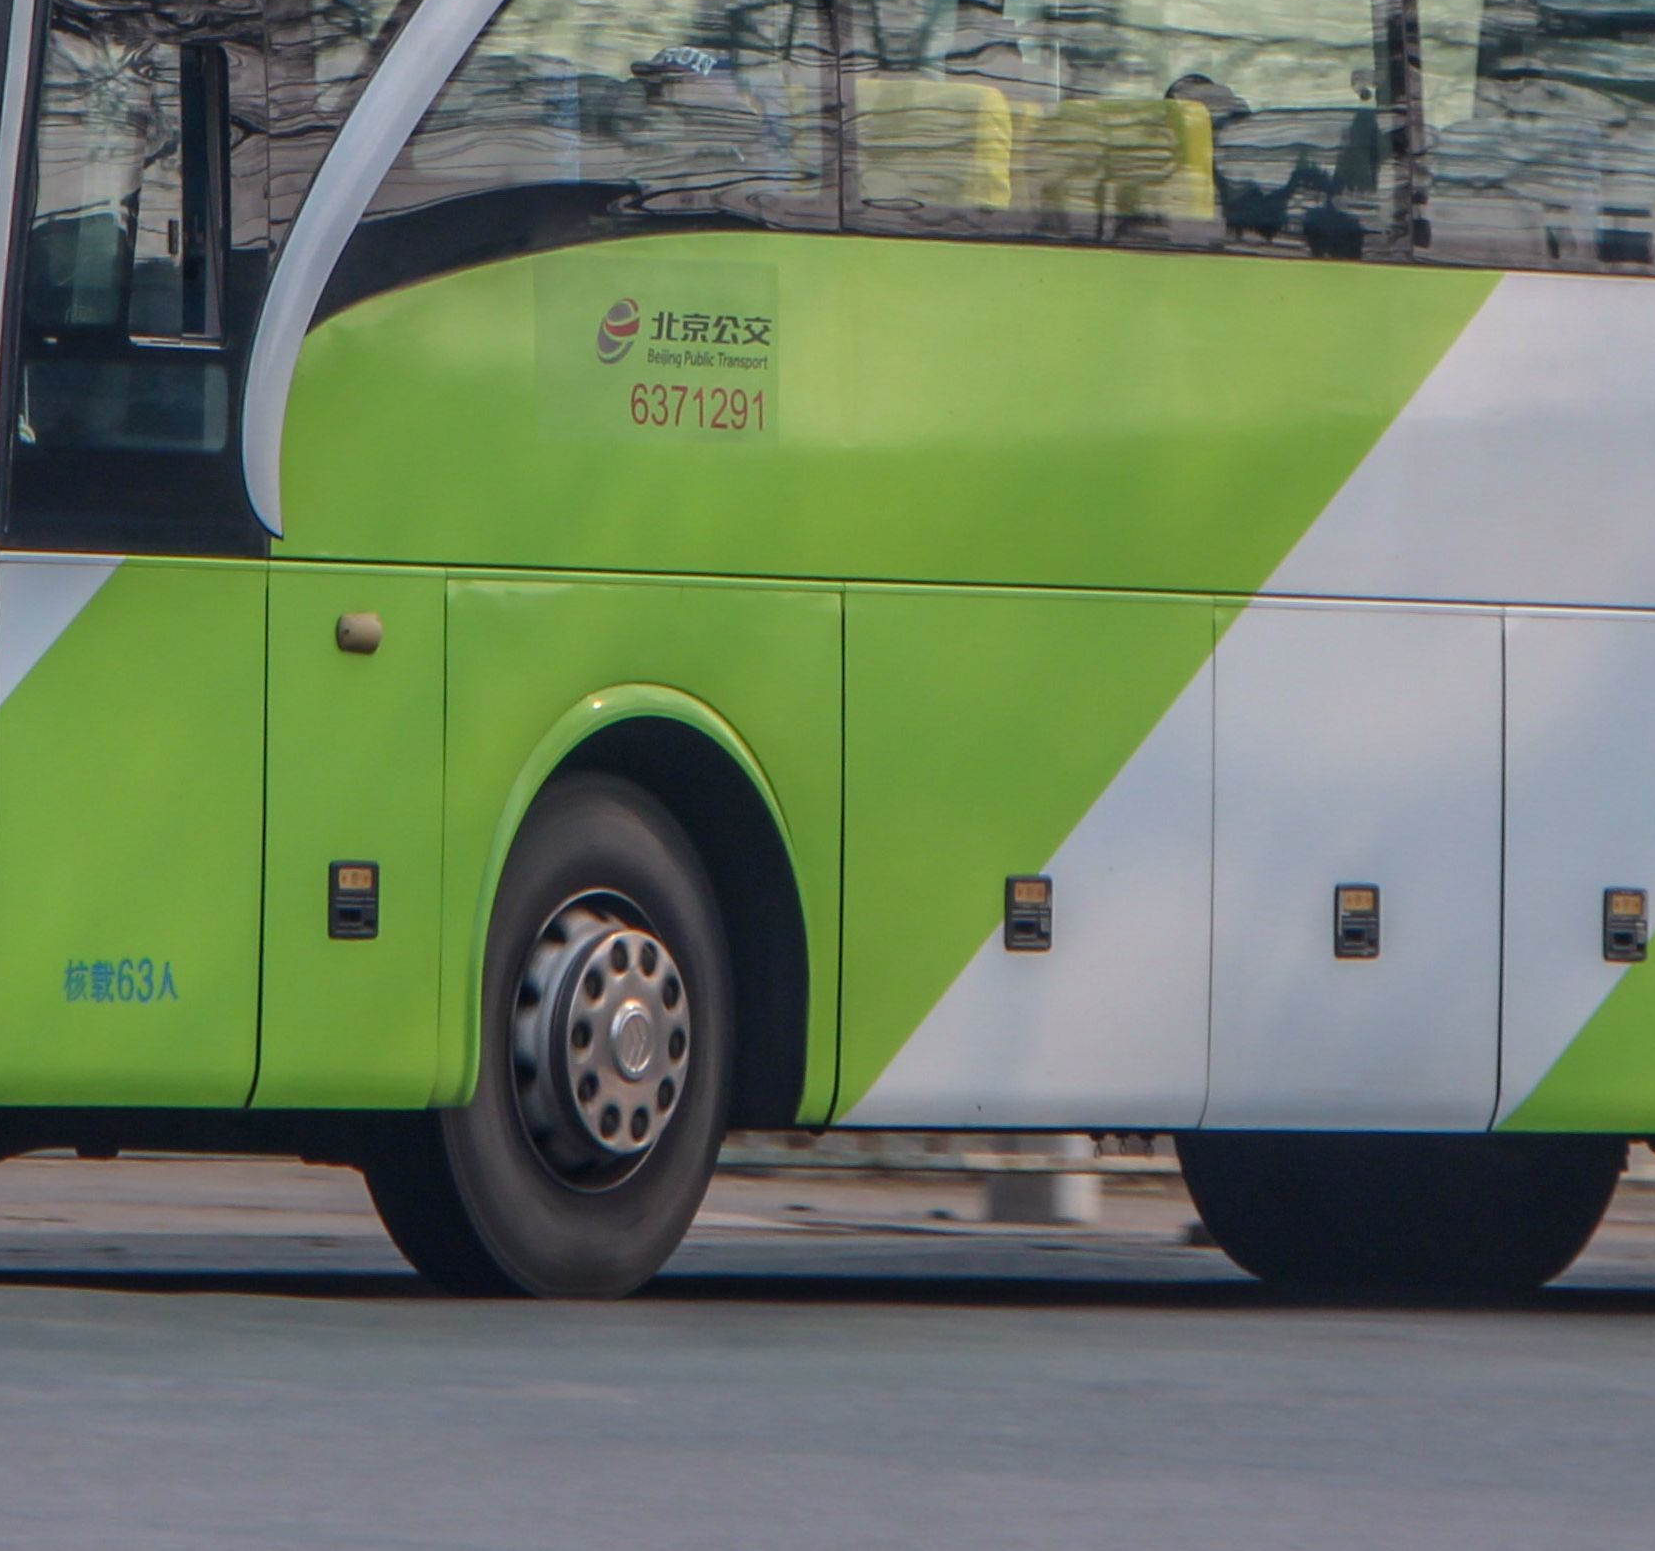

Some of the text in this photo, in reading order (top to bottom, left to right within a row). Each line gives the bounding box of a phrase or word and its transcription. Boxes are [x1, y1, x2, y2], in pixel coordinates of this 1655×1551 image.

[649, 311, 772, 346] 北京公交
[647, 349, 768, 370] Beijing Public Transport
[630, 382, 763, 432] 6371291
